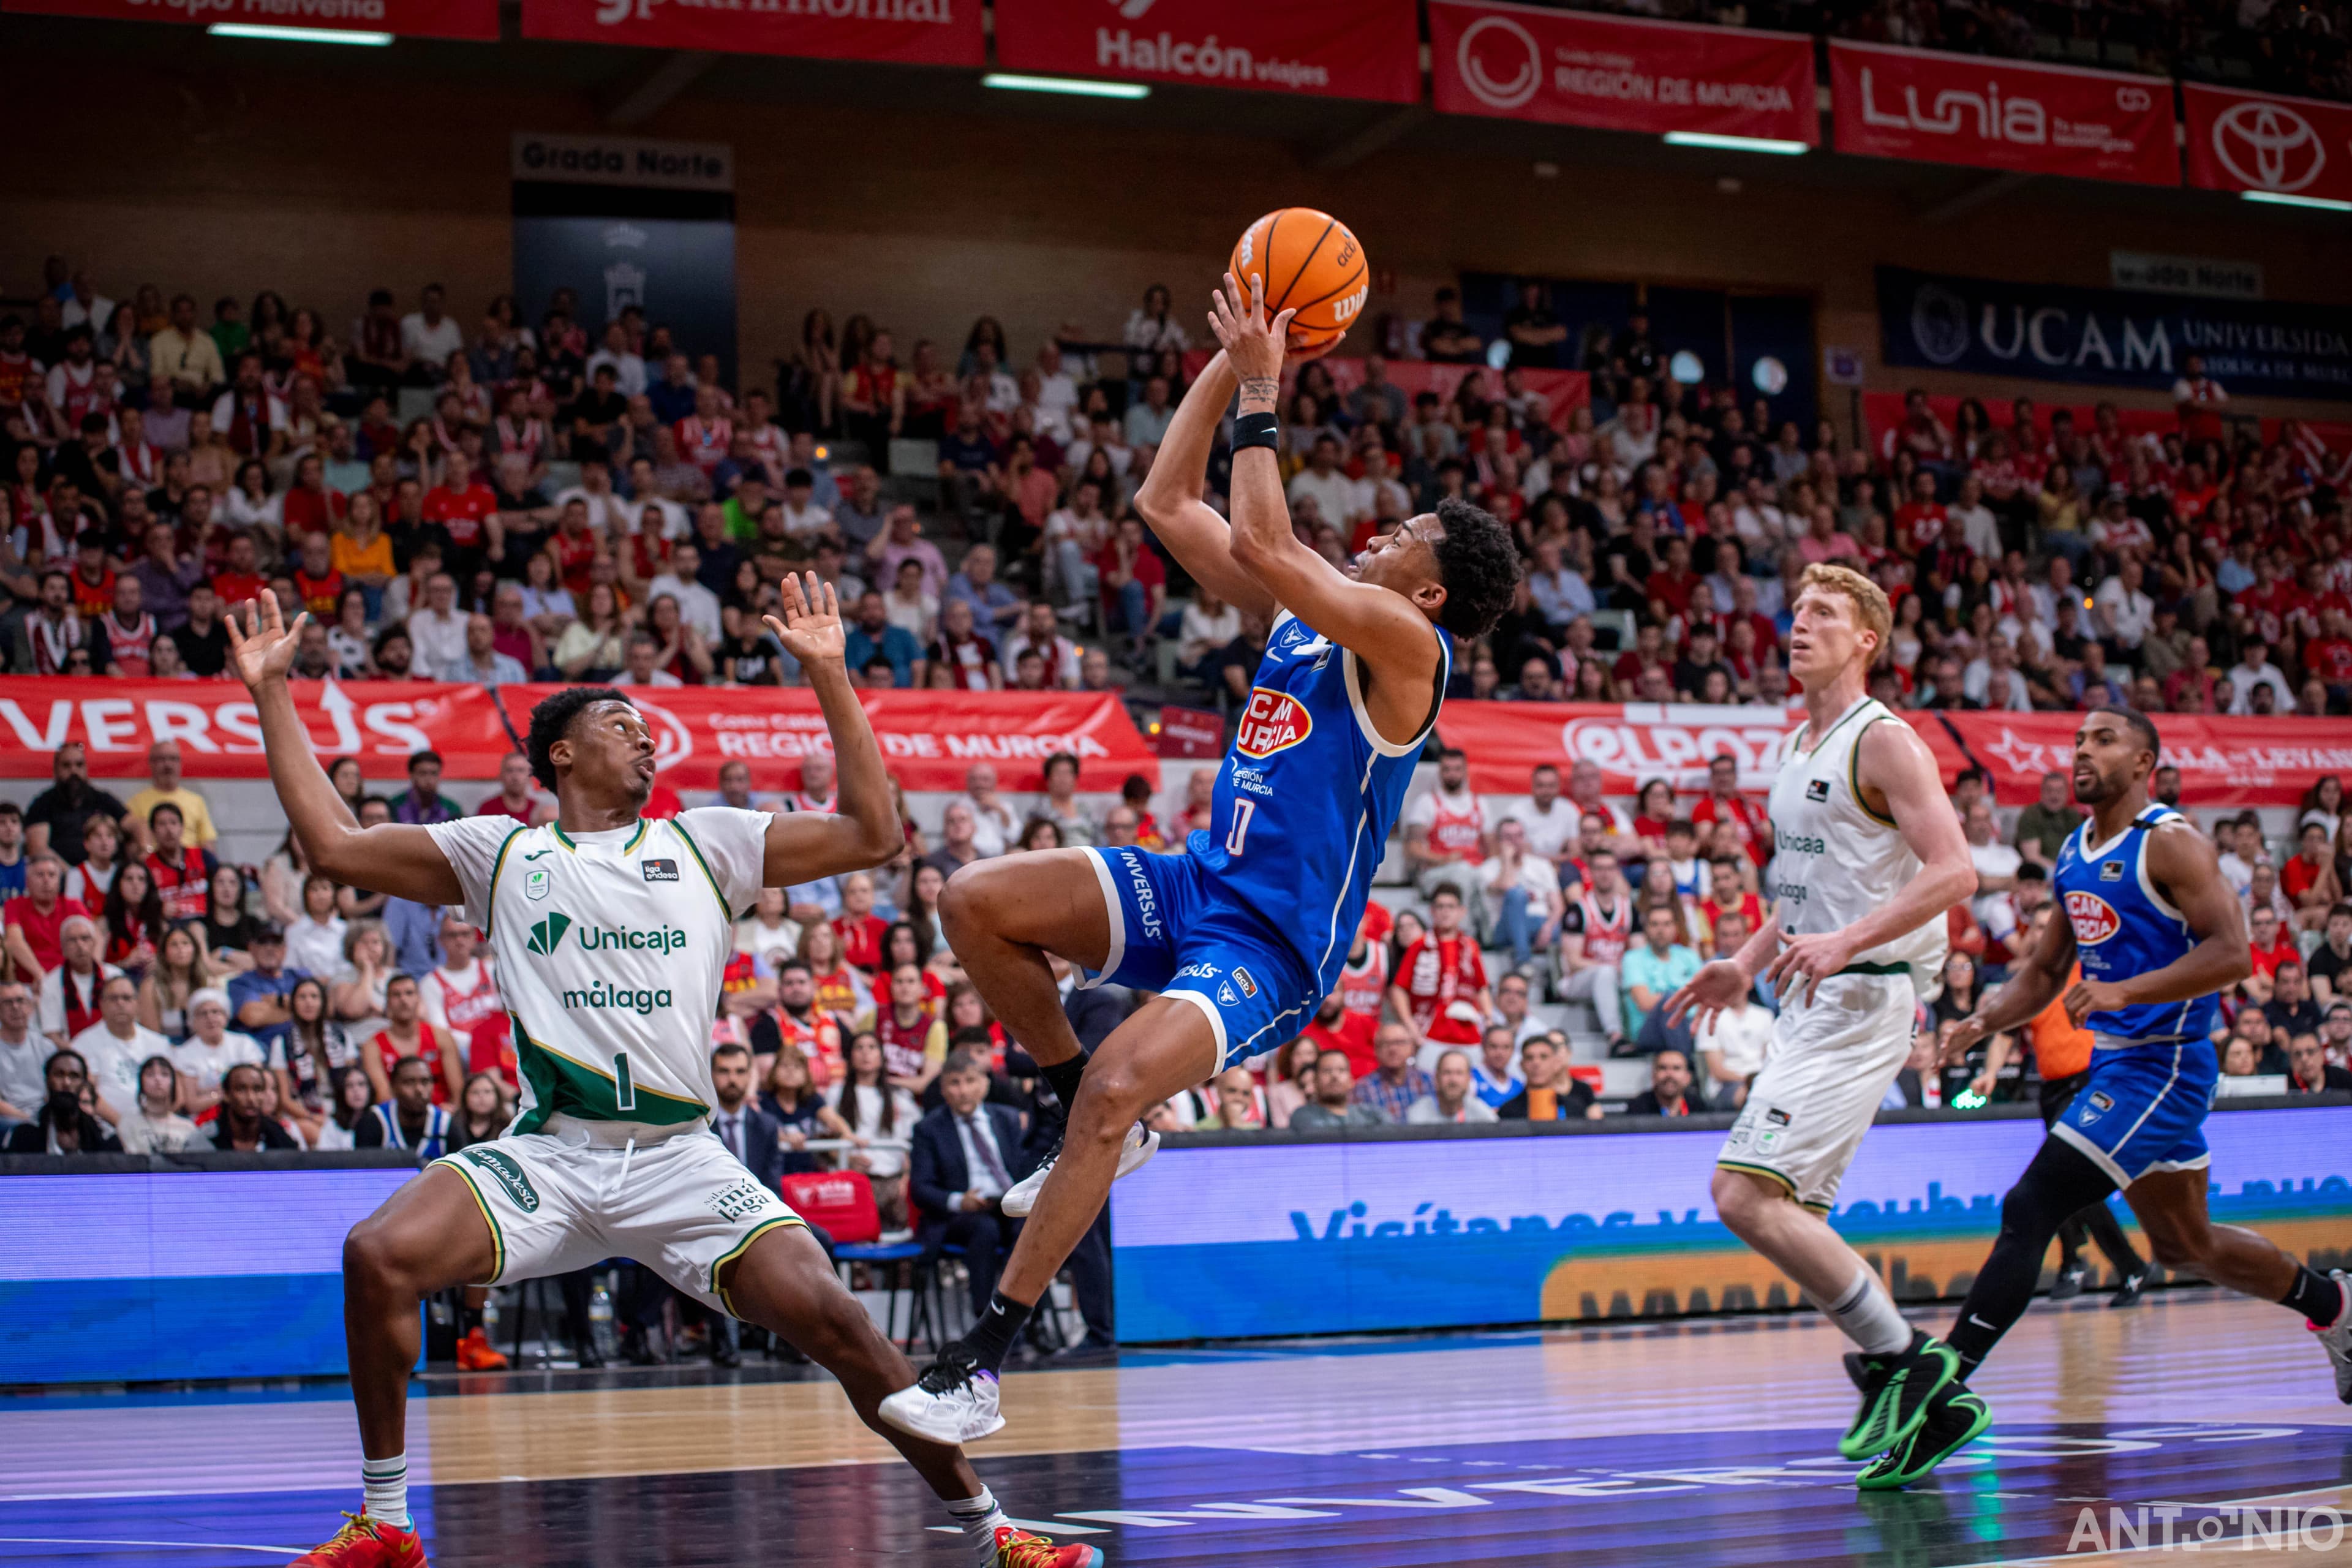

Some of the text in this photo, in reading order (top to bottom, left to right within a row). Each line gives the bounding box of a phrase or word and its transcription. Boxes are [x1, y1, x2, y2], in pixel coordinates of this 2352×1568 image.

[1096, 26, 1253, 80] Halcón
[1657, 76, 1692, 106] DE
[1696, 80, 1793, 111] MURCIA
[523, 142, 723, 178] Grada Norte
[1980, 303, 2174, 374] UCAM
[1248, 693, 1293, 723] CAM
[881, 734, 940, 757] DE
[945, 734, 1109, 758] MURCIA
[1238, 723, 1297, 753] URCIA
[1241, 780, 1273, 796] MURCIA
[1121, 852, 1161, 939] INVERSUS
[2065, 895, 2103, 919] CAM
[579, 924, 687, 956] Unicaja
[1235, 973, 1250, 992] acb
[613, 1052, 636, 1112] 1
[718, 1194, 771, 1224] laga
